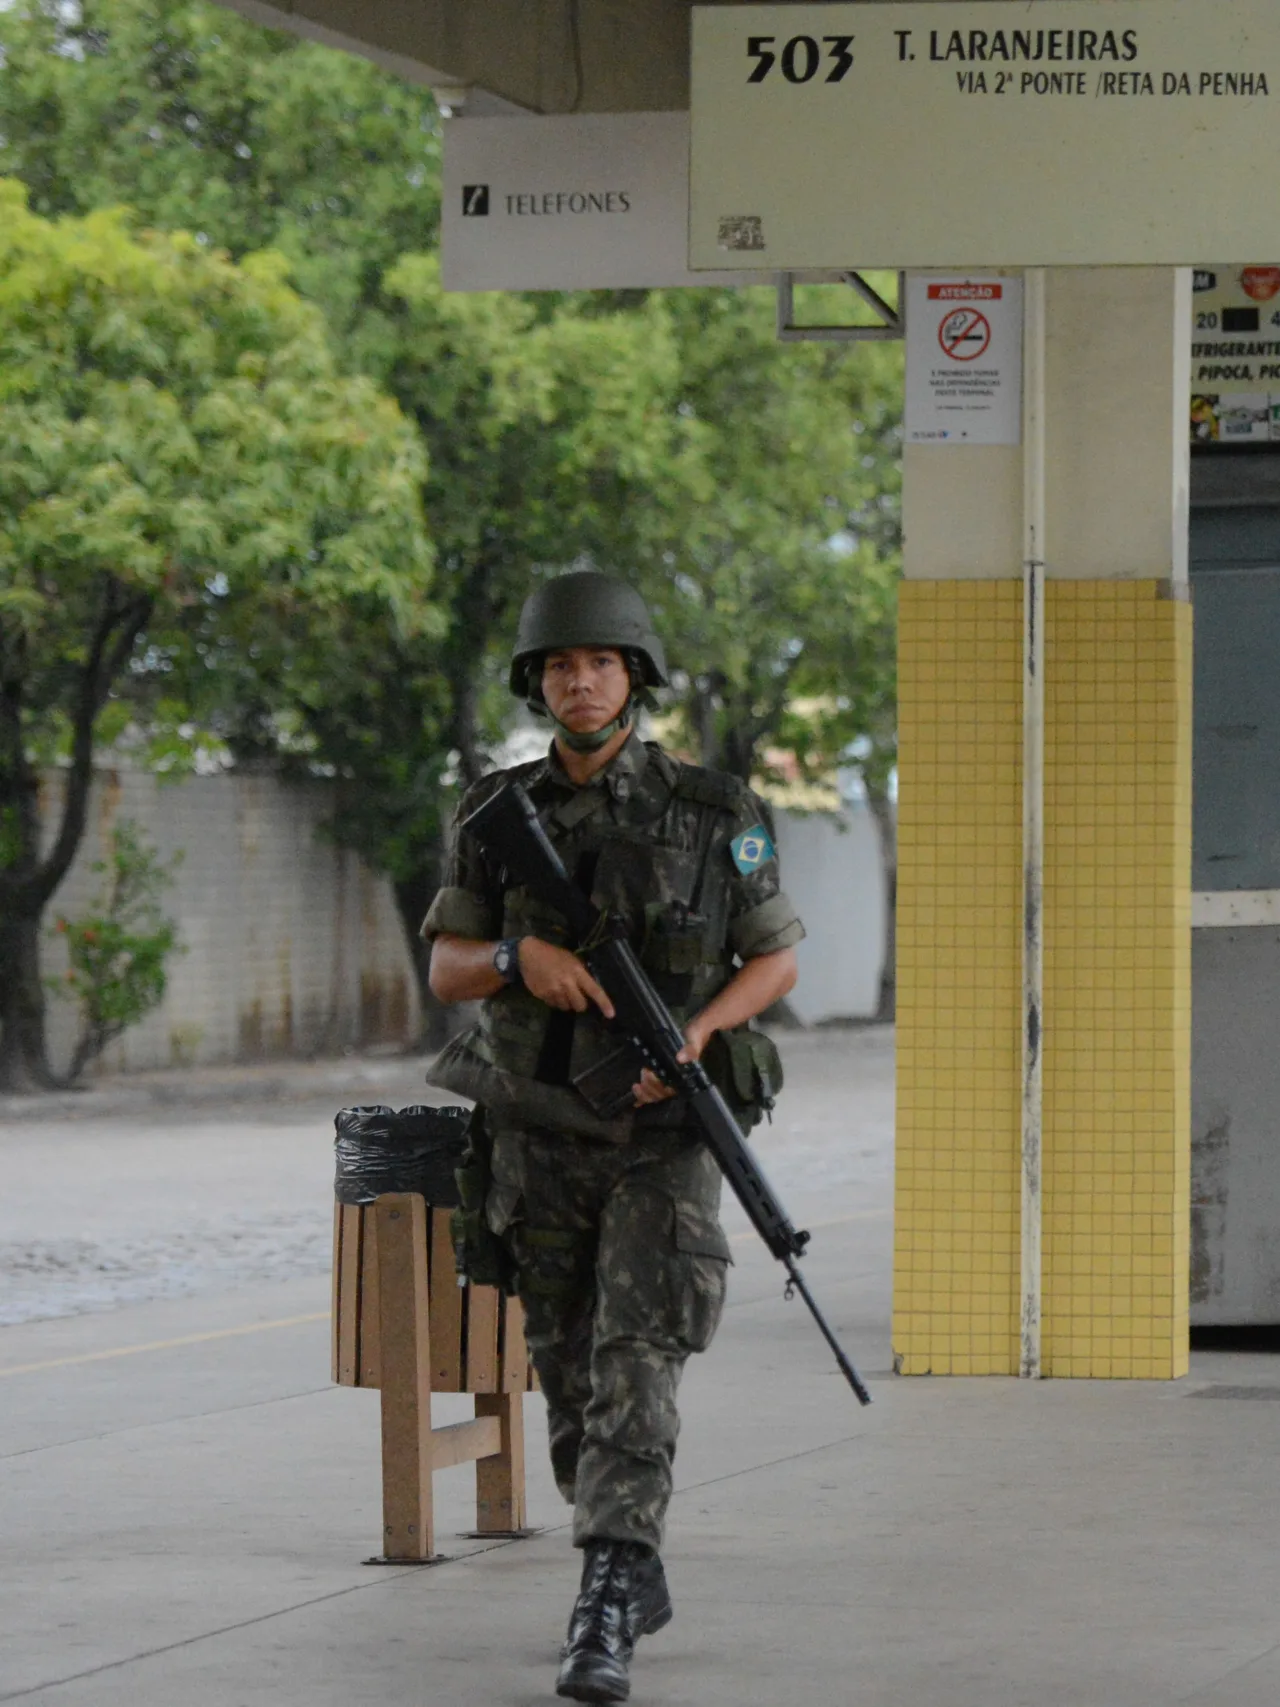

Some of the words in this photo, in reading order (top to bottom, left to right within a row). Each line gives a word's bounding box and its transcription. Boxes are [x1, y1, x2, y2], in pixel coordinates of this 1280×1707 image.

[747, 35, 855, 84] 503
[894, 30, 915, 61] T.
[929, 29, 1138, 62] LARANJEIRAS
[956, 71, 987, 94] VIA
[1020, 72, 1086, 94] PONTE
[1162, 72, 1191, 95] DA
[1200, 72, 1268, 96] PENHA
[504, 190, 631, 216] TELEFONES
[1196, 311, 1217, 329] 20
